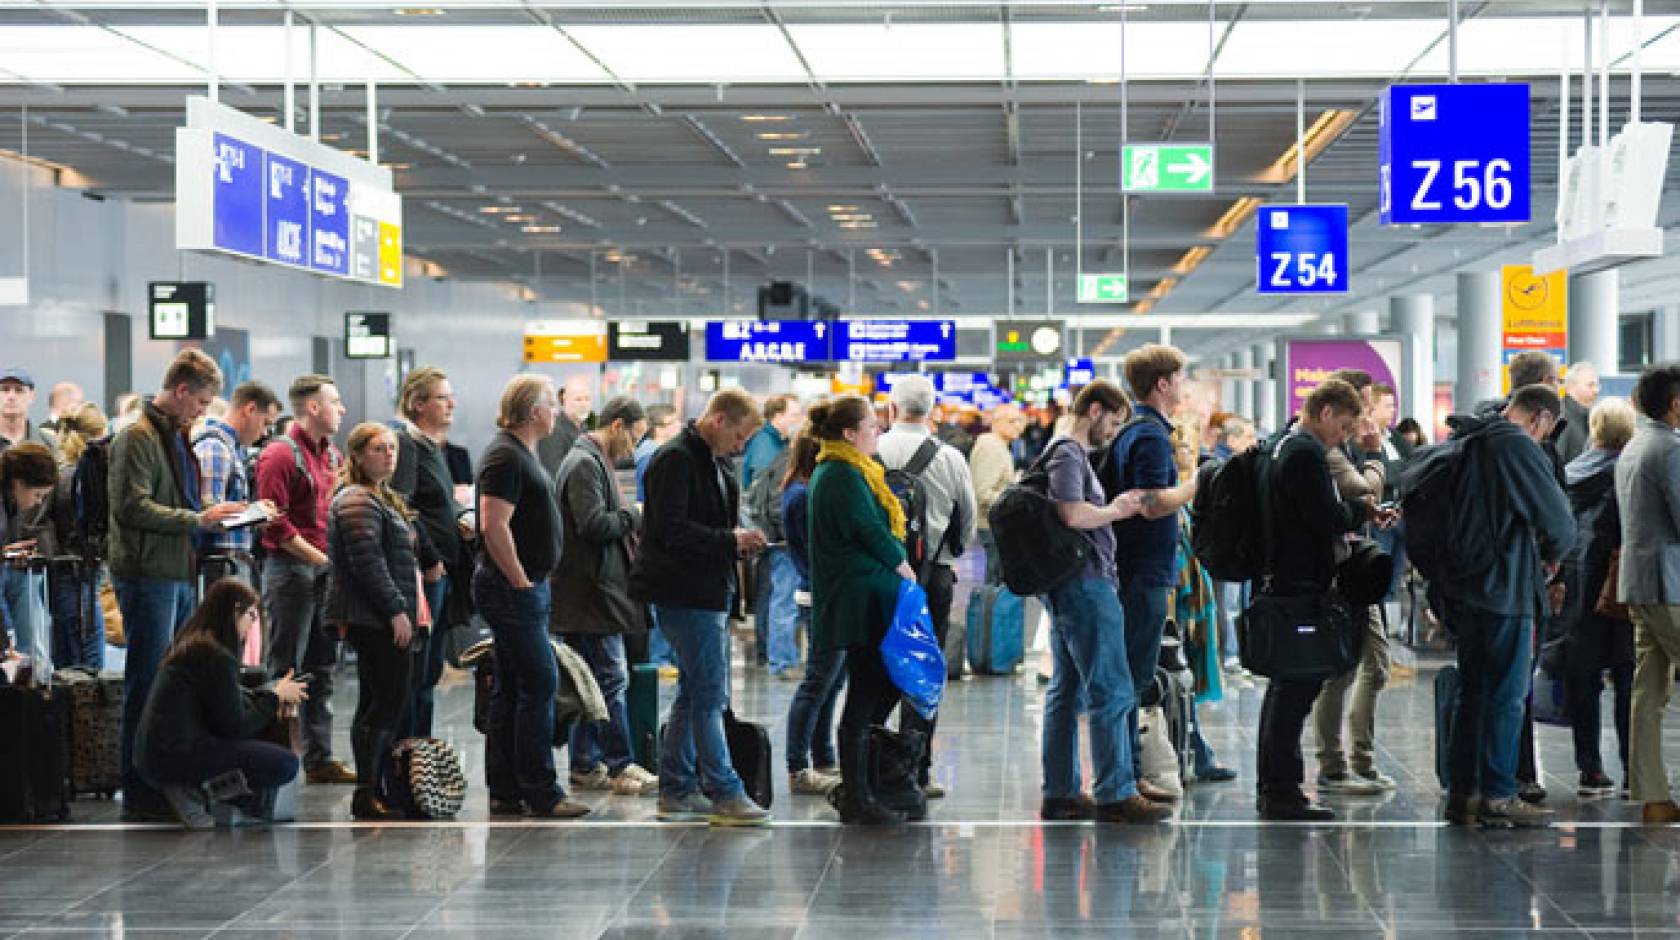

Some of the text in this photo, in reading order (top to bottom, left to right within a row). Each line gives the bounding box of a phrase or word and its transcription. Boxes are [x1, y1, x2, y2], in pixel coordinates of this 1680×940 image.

[1411, 160, 1442, 210] Z
[1453, 158, 1513, 210] 56
[1270, 251, 1338, 287] Z 54
